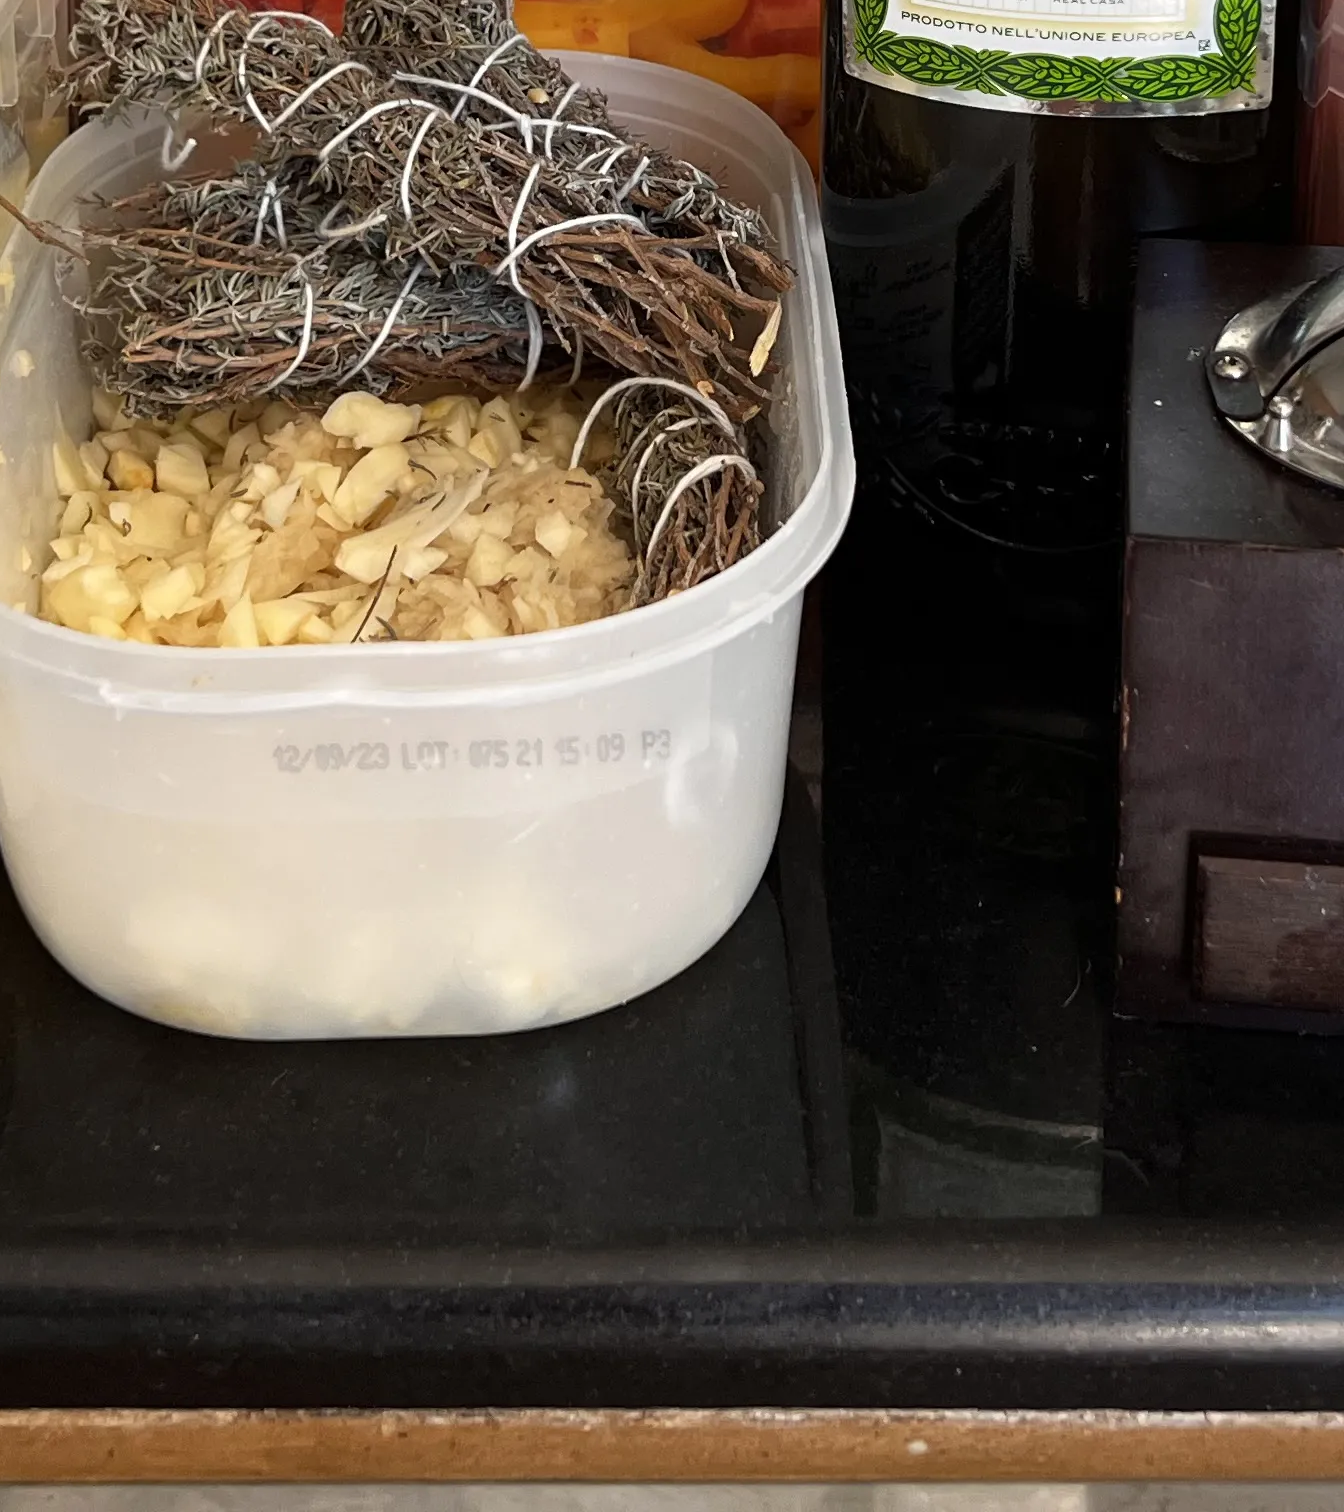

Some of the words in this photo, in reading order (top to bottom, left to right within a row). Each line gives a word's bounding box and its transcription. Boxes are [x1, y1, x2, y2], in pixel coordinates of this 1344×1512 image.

[901, 10, 987, 34] PRODOTTO
[992, 26, 1107, 43] NELL'UNIONE
[1111, 30, 1197, 43] EUROPEA
[641, 729, 672, 762] P3
